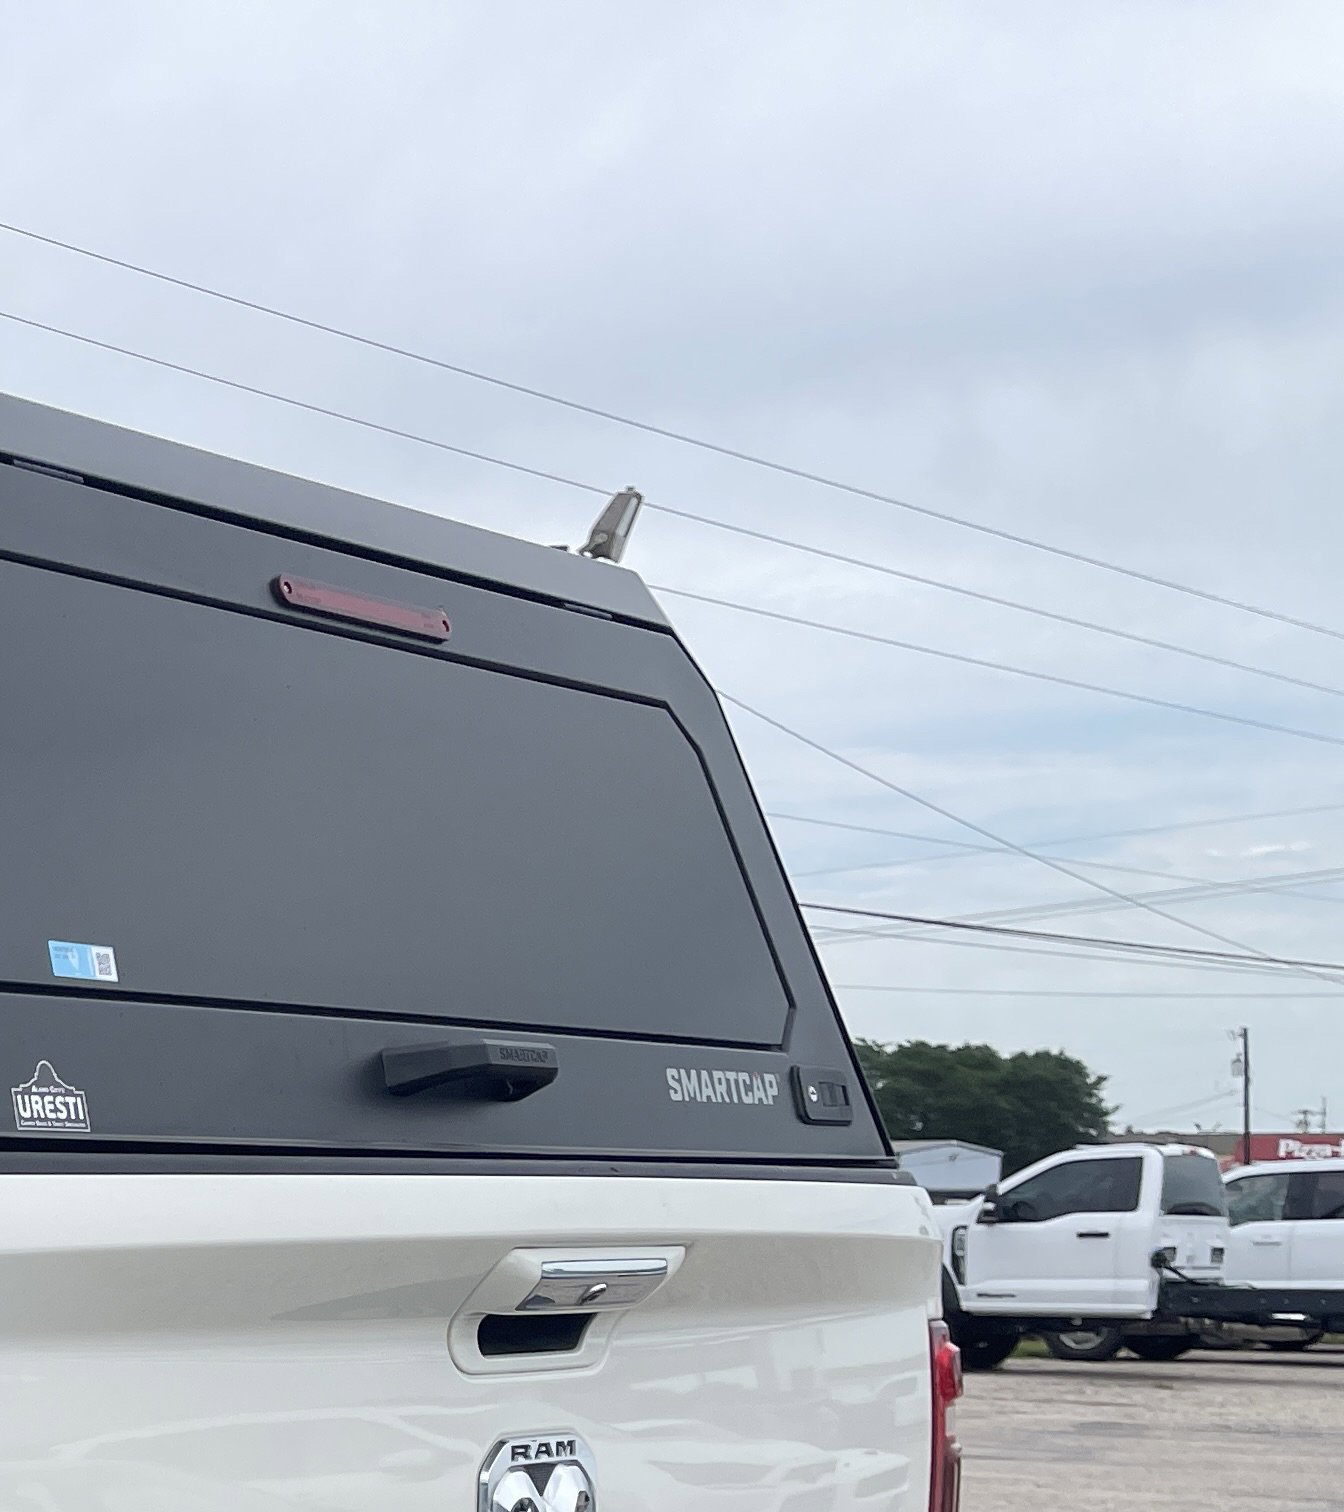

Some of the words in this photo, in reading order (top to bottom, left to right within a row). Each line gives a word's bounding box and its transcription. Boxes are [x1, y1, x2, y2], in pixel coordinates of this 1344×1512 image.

[665, 1067, 780, 1106] SMARTCAP
[16, 1094, 85, 1120] URESTI
[510, 1440, 577, 1462] RAM
